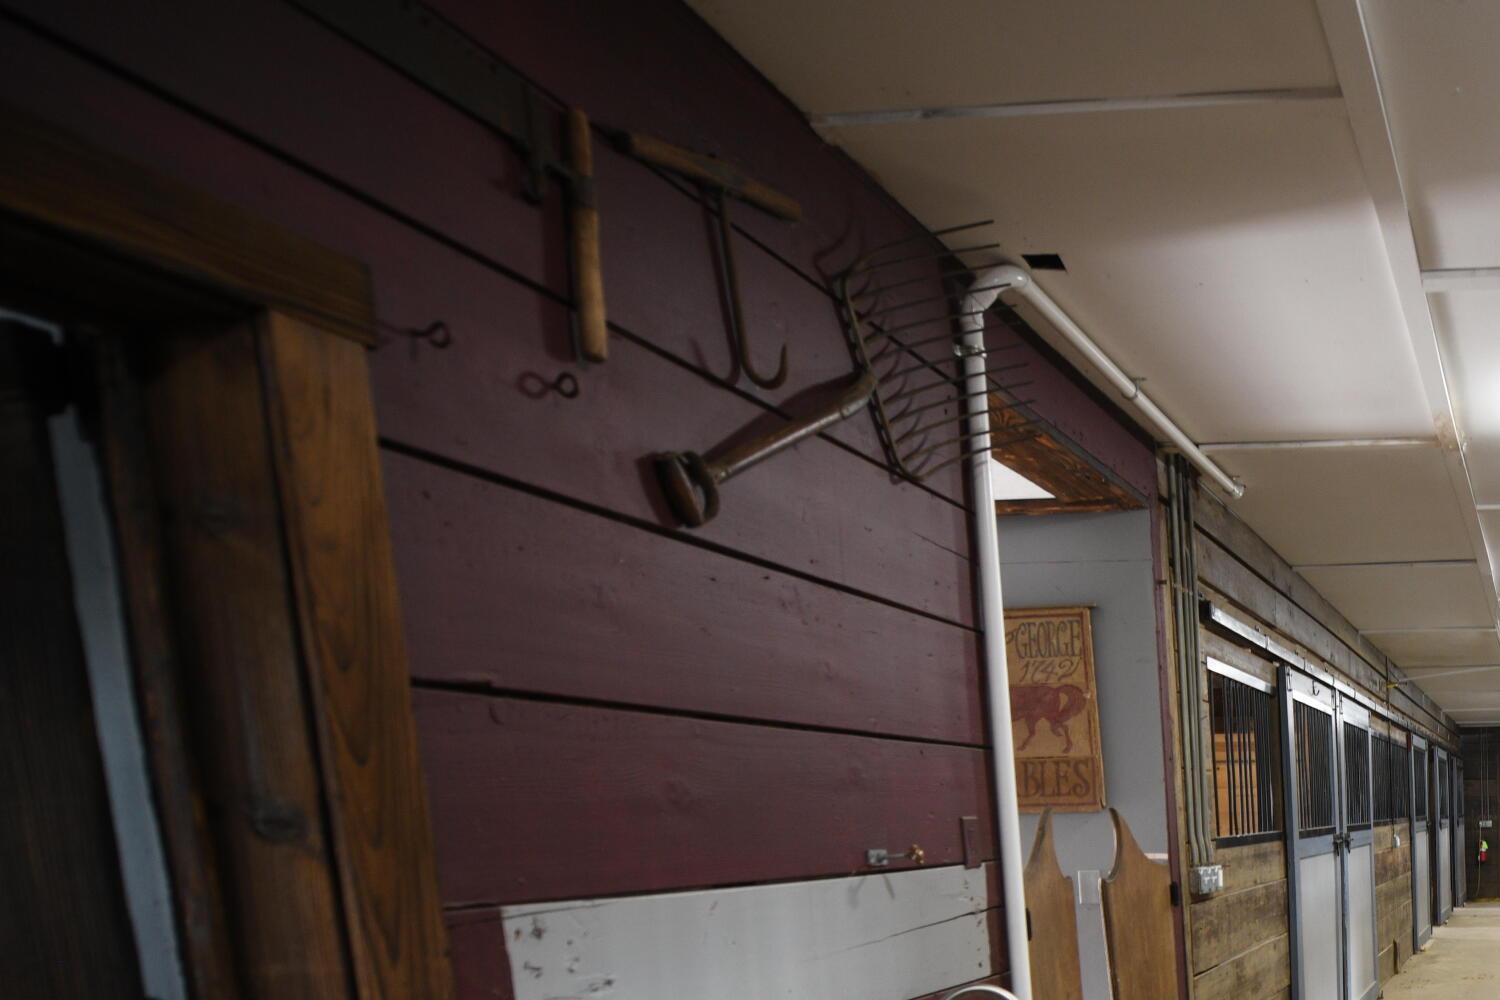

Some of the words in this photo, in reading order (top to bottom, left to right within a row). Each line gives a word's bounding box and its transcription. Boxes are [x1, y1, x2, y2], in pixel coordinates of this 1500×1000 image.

[1015, 619, 1082, 660] GEORGE
[1019, 658, 1082, 684] 1742
[1018, 759, 1091, 798] BLES
